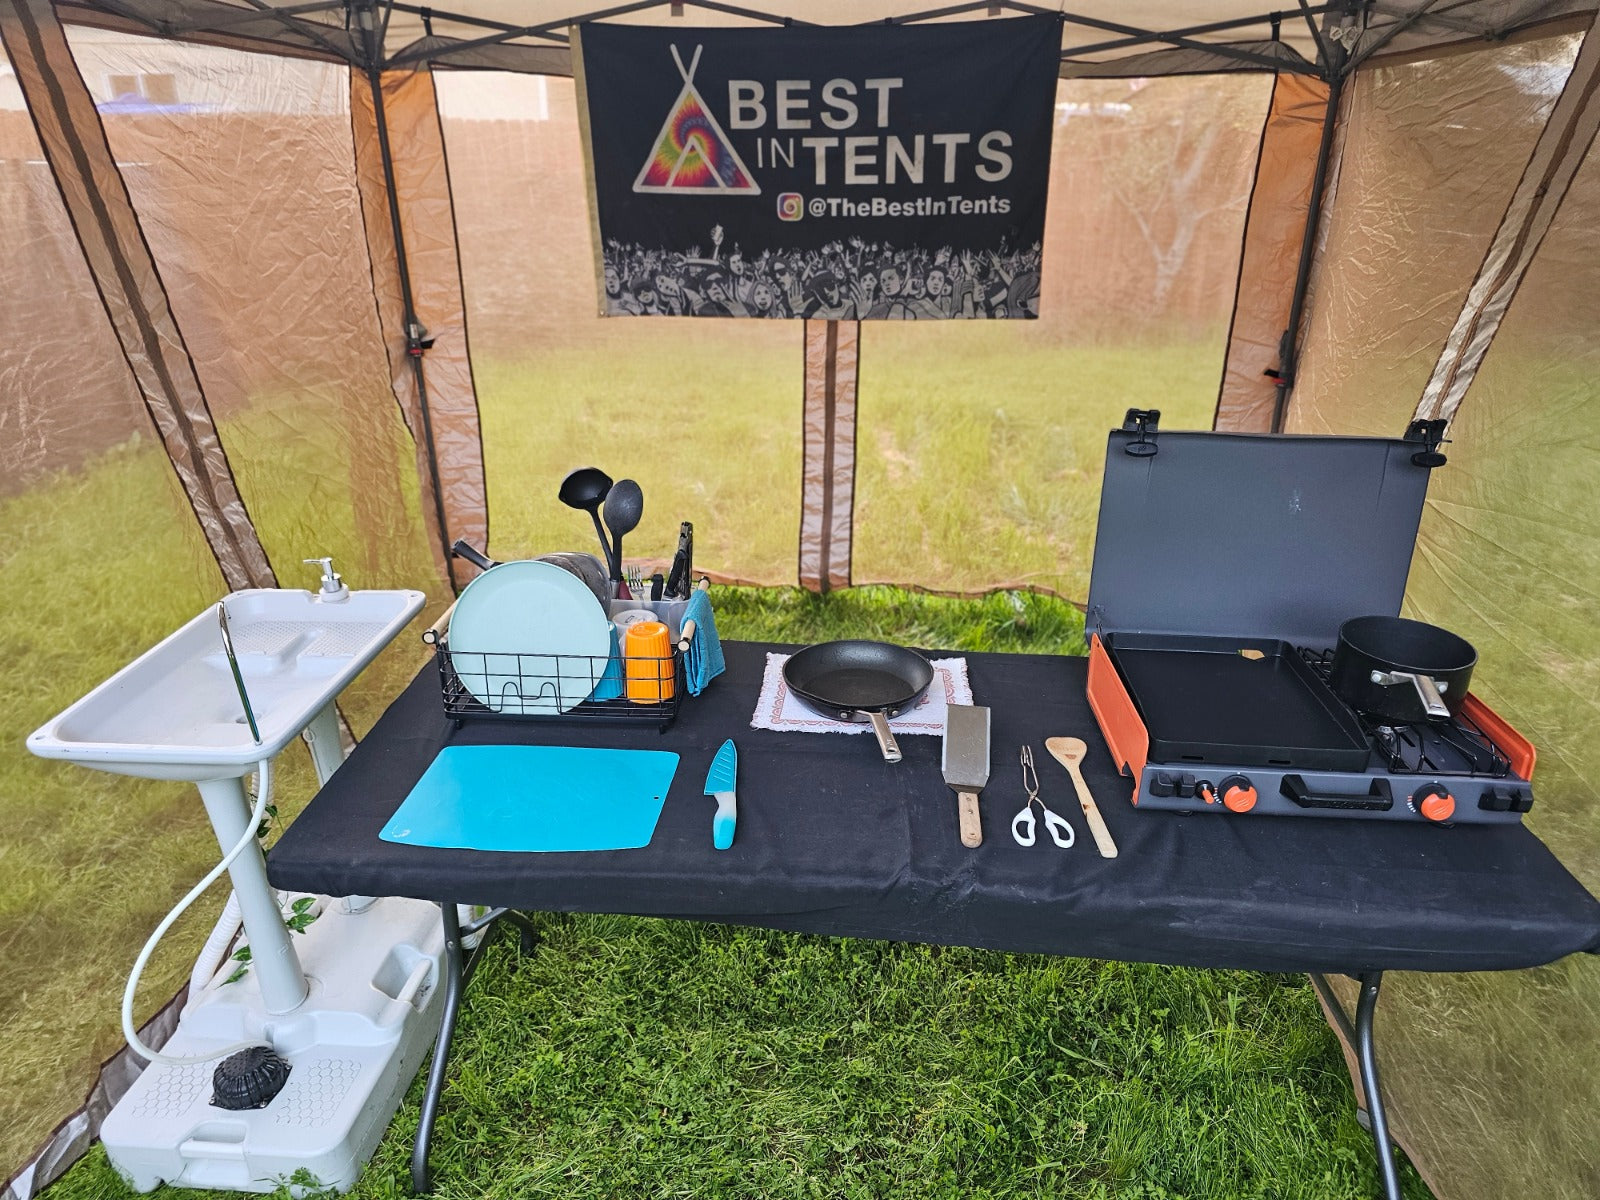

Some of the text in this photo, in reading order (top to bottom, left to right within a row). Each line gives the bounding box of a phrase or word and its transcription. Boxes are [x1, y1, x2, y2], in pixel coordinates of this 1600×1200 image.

[728, 77, 904, 130] BEST
[757, 130, 1013, 185] IN TENTS
[808, 195, 1011, 218] @TheBestInTents
